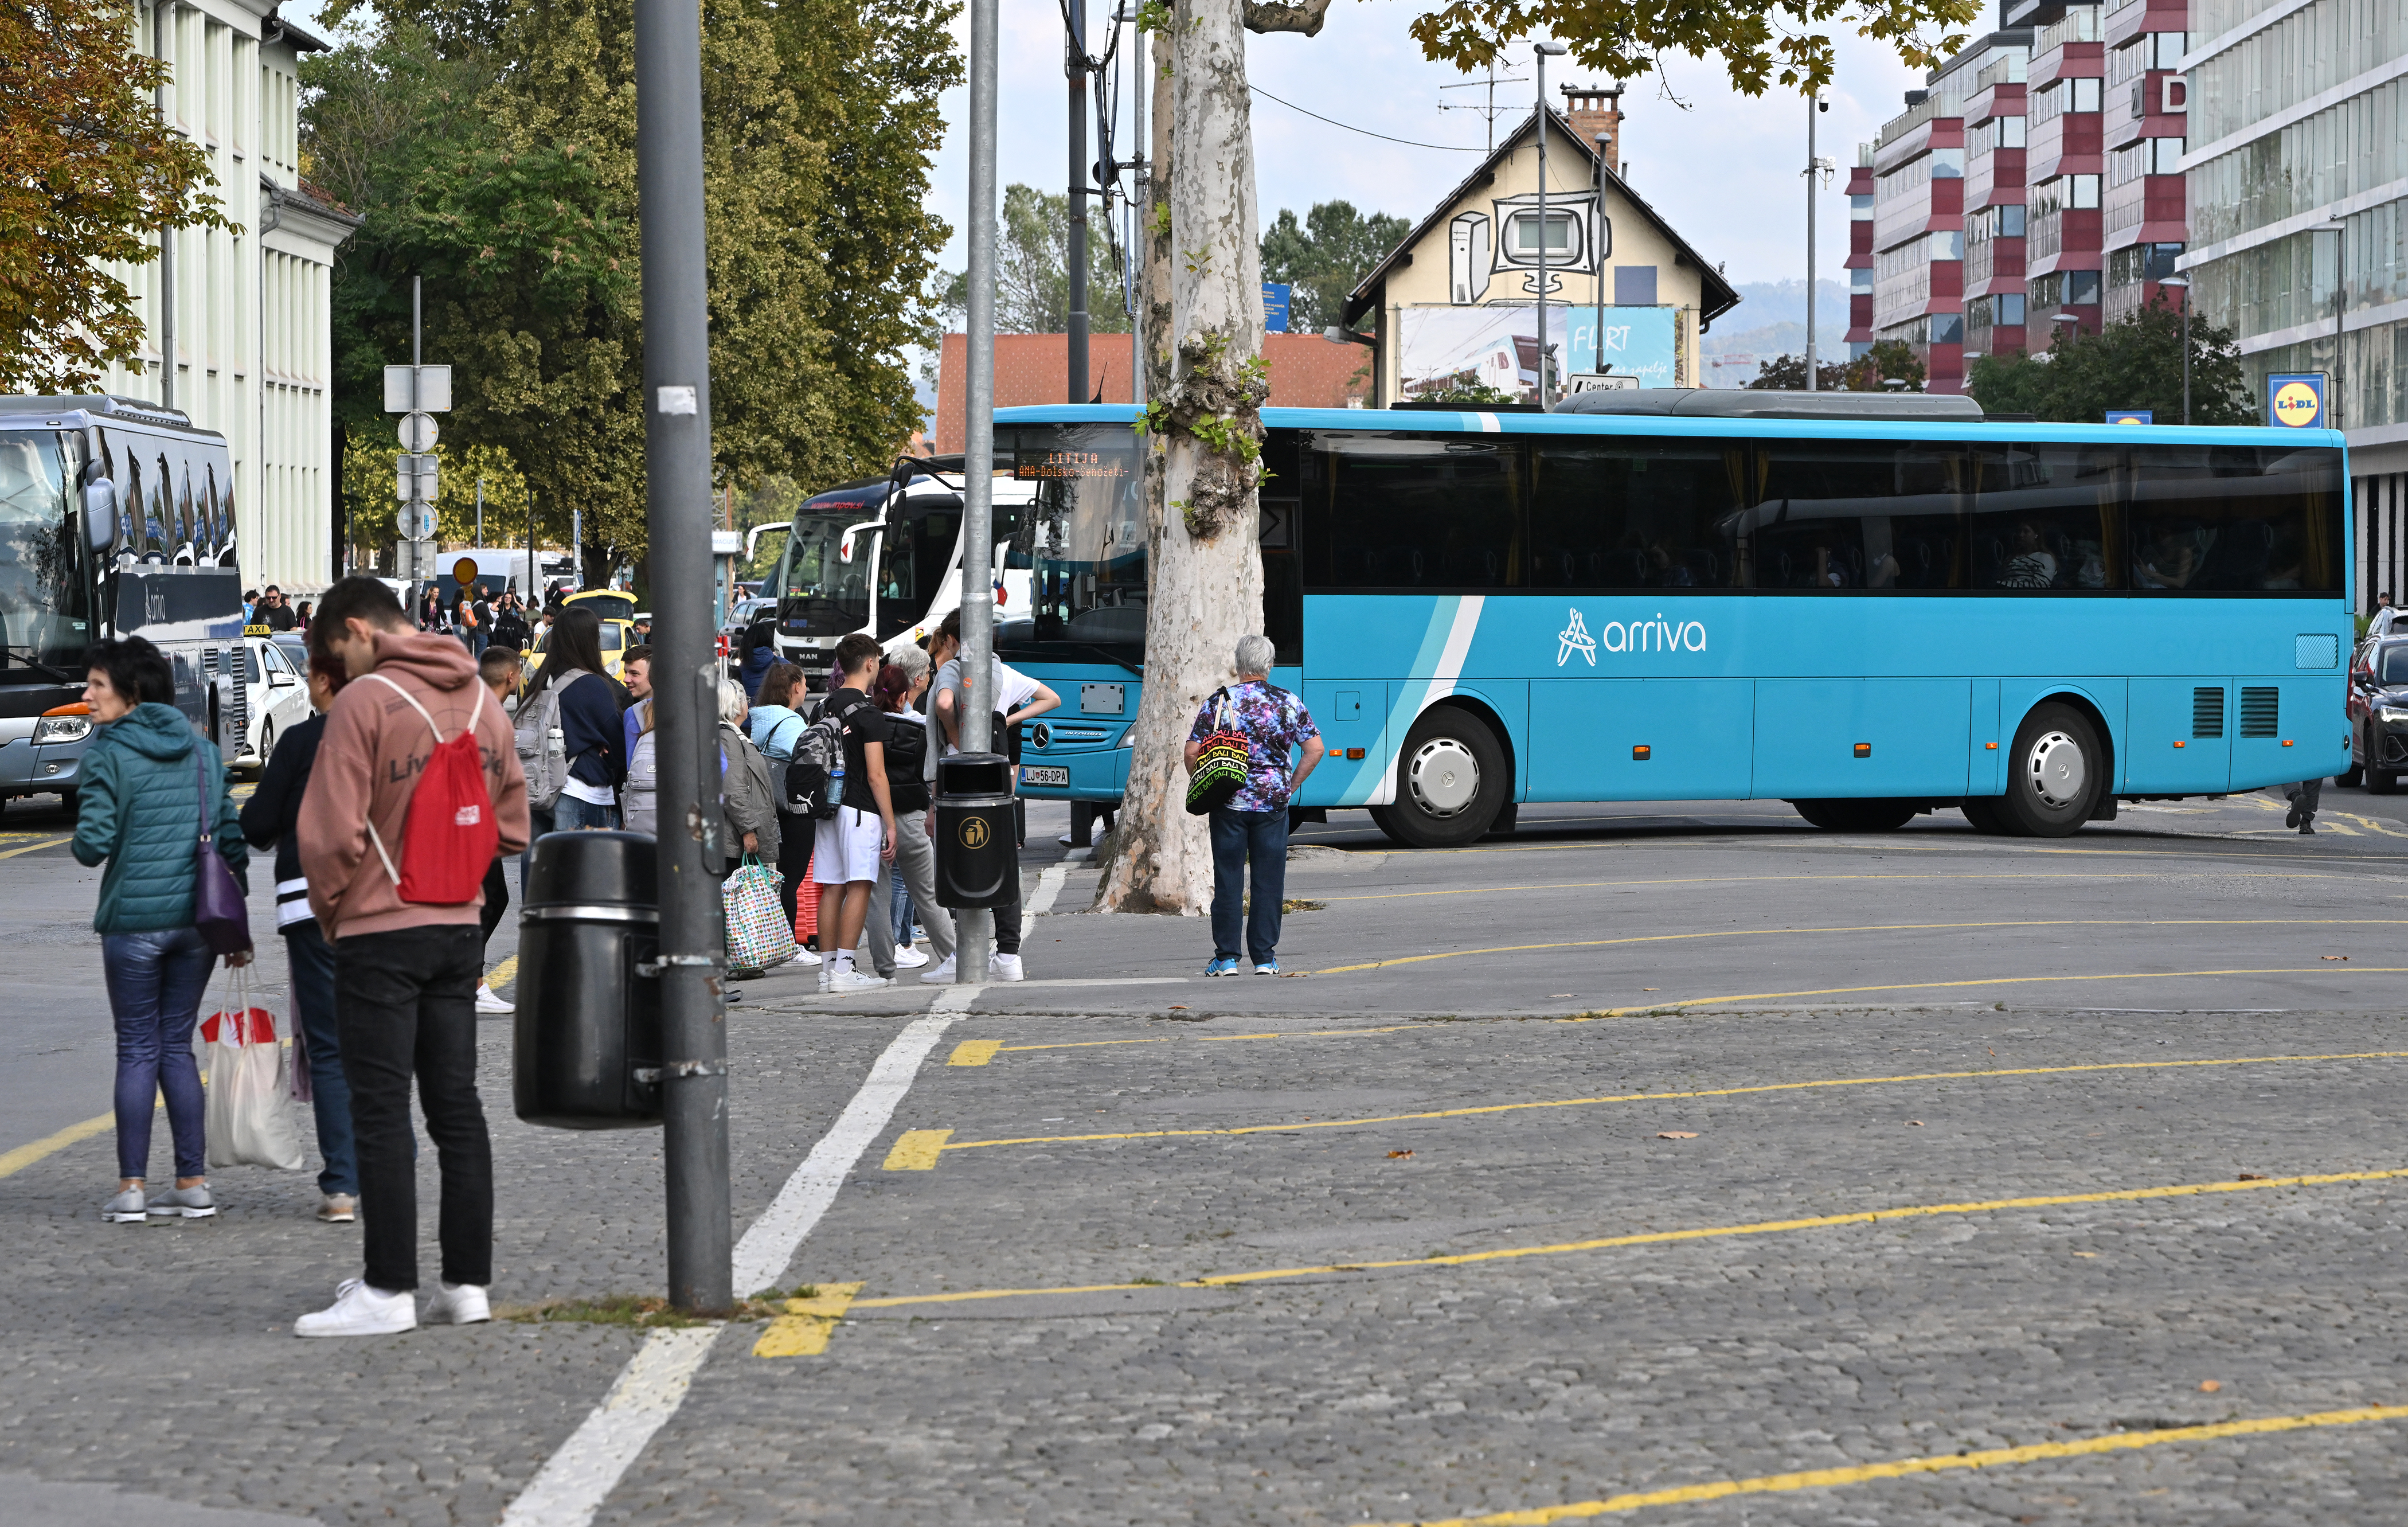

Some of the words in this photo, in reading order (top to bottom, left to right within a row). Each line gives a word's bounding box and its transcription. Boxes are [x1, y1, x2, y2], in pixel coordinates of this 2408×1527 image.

[1574, 325, 1631, 352] FLRT
[1630, 361, 1667, 380] zapelje
[1586, 381, 1613, 391] Center
[1049, 453, 1098, 464] LITIJA
[811, 501, 865, 510] www.mpov.si
[1603, 612, 1706, 652] arriva
[1201, 733, 1213, 744] ALI
[1232, 731, 1247, 739] BAL
[1222, 739, 1238, 749] BALI
[1213, 749, 1229, 757] BALI
[1232, 751, 1246, 763] BALI
[390, 752, 429, 783] Liv
[1194, 771, 1205, 783] BALI
[1206, 761, 1218, 774] BALI
[1221, 760, 1238, 769] BALI
[1026, 770, 1035, 781] LJ
[1041, 770, 1066, 782] 56-DPA
[1193, 787, 1203, 800] BALI
[1202, 776, 1214, 790] BALI
[1214, 770, 1228, 780] BALI
[1230, 772, 1245, 784] BALI
[789, 802, 808, 814] PUMA
